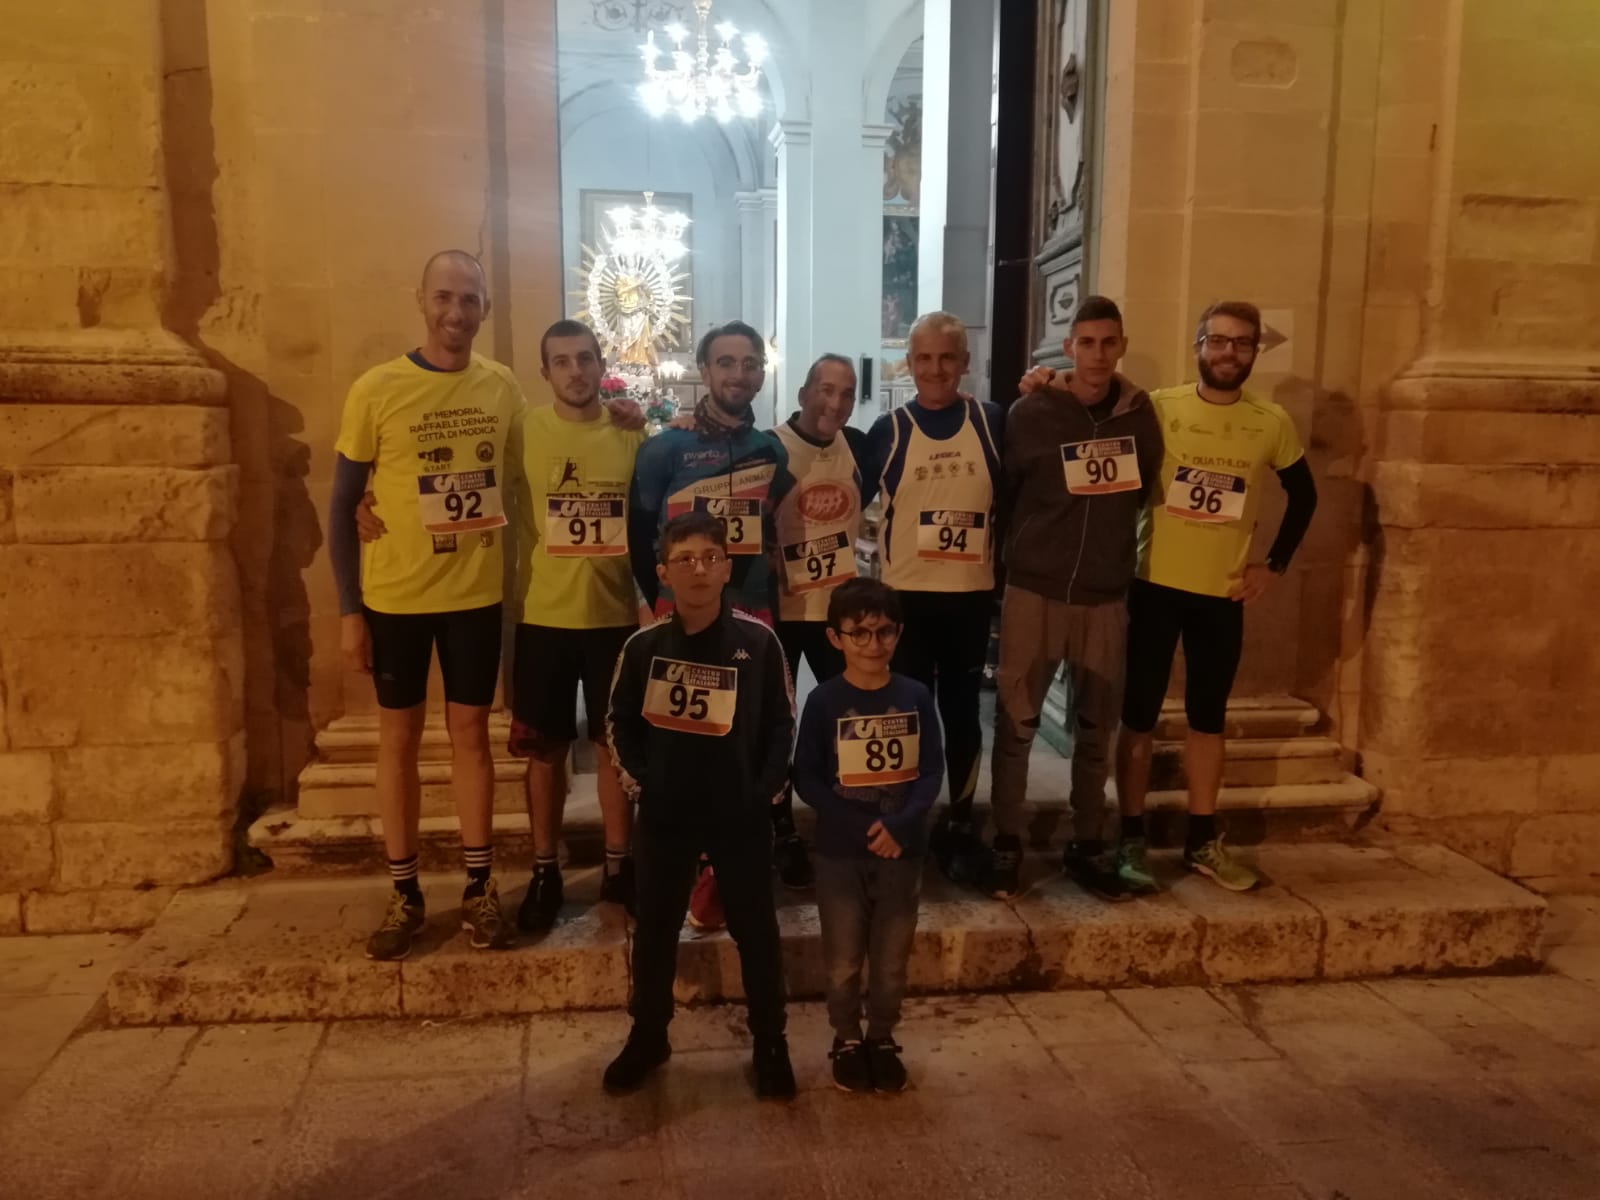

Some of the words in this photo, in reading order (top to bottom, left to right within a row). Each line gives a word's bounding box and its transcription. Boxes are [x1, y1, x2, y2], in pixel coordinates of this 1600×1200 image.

[409, 420, 460, 434] RAFFAELE
[461, 415, 499, 427] DENARO
[435, 407, 485, 420] MEMORIAL
[447, 430, 457, 439] DI
[459, 426, 496, 438] MODICA
[1086, 457, 1118, 484] 90
[444, 491, 483, 521] 92
[1189, 486, 1223, 514] 96
[568, 518, 605, 545] 91
[938, 526, 968, 552] 94
[806, 552, 836, 581] 97
[669, 684, 710, 720] 95
[865, 738, 904, 772] 89
